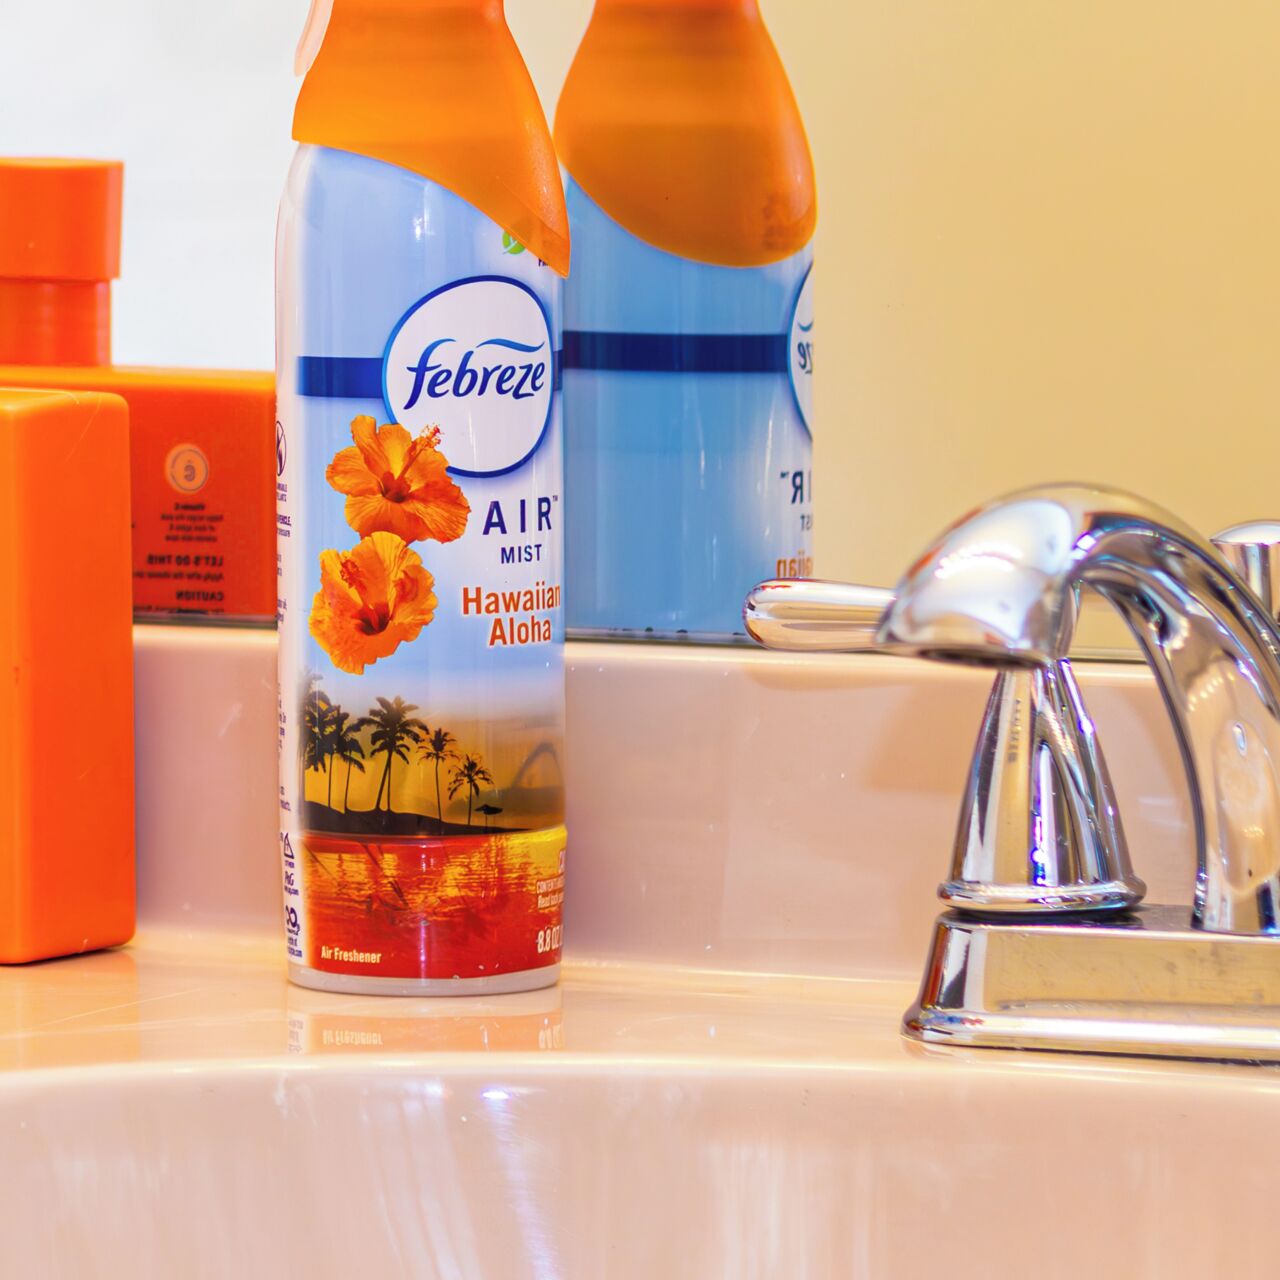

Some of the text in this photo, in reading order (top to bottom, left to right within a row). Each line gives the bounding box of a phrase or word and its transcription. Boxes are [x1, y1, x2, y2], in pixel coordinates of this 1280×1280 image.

[403, 338, 545, 410] febreze
[501, 544, 543, 565] MIST
[462, 580, 561, 616] Hawaiian
[488, 615, 552, 647] Aloha
[321, 945, 332, 959] Air
[334, 946, 382, 964] Freshener
